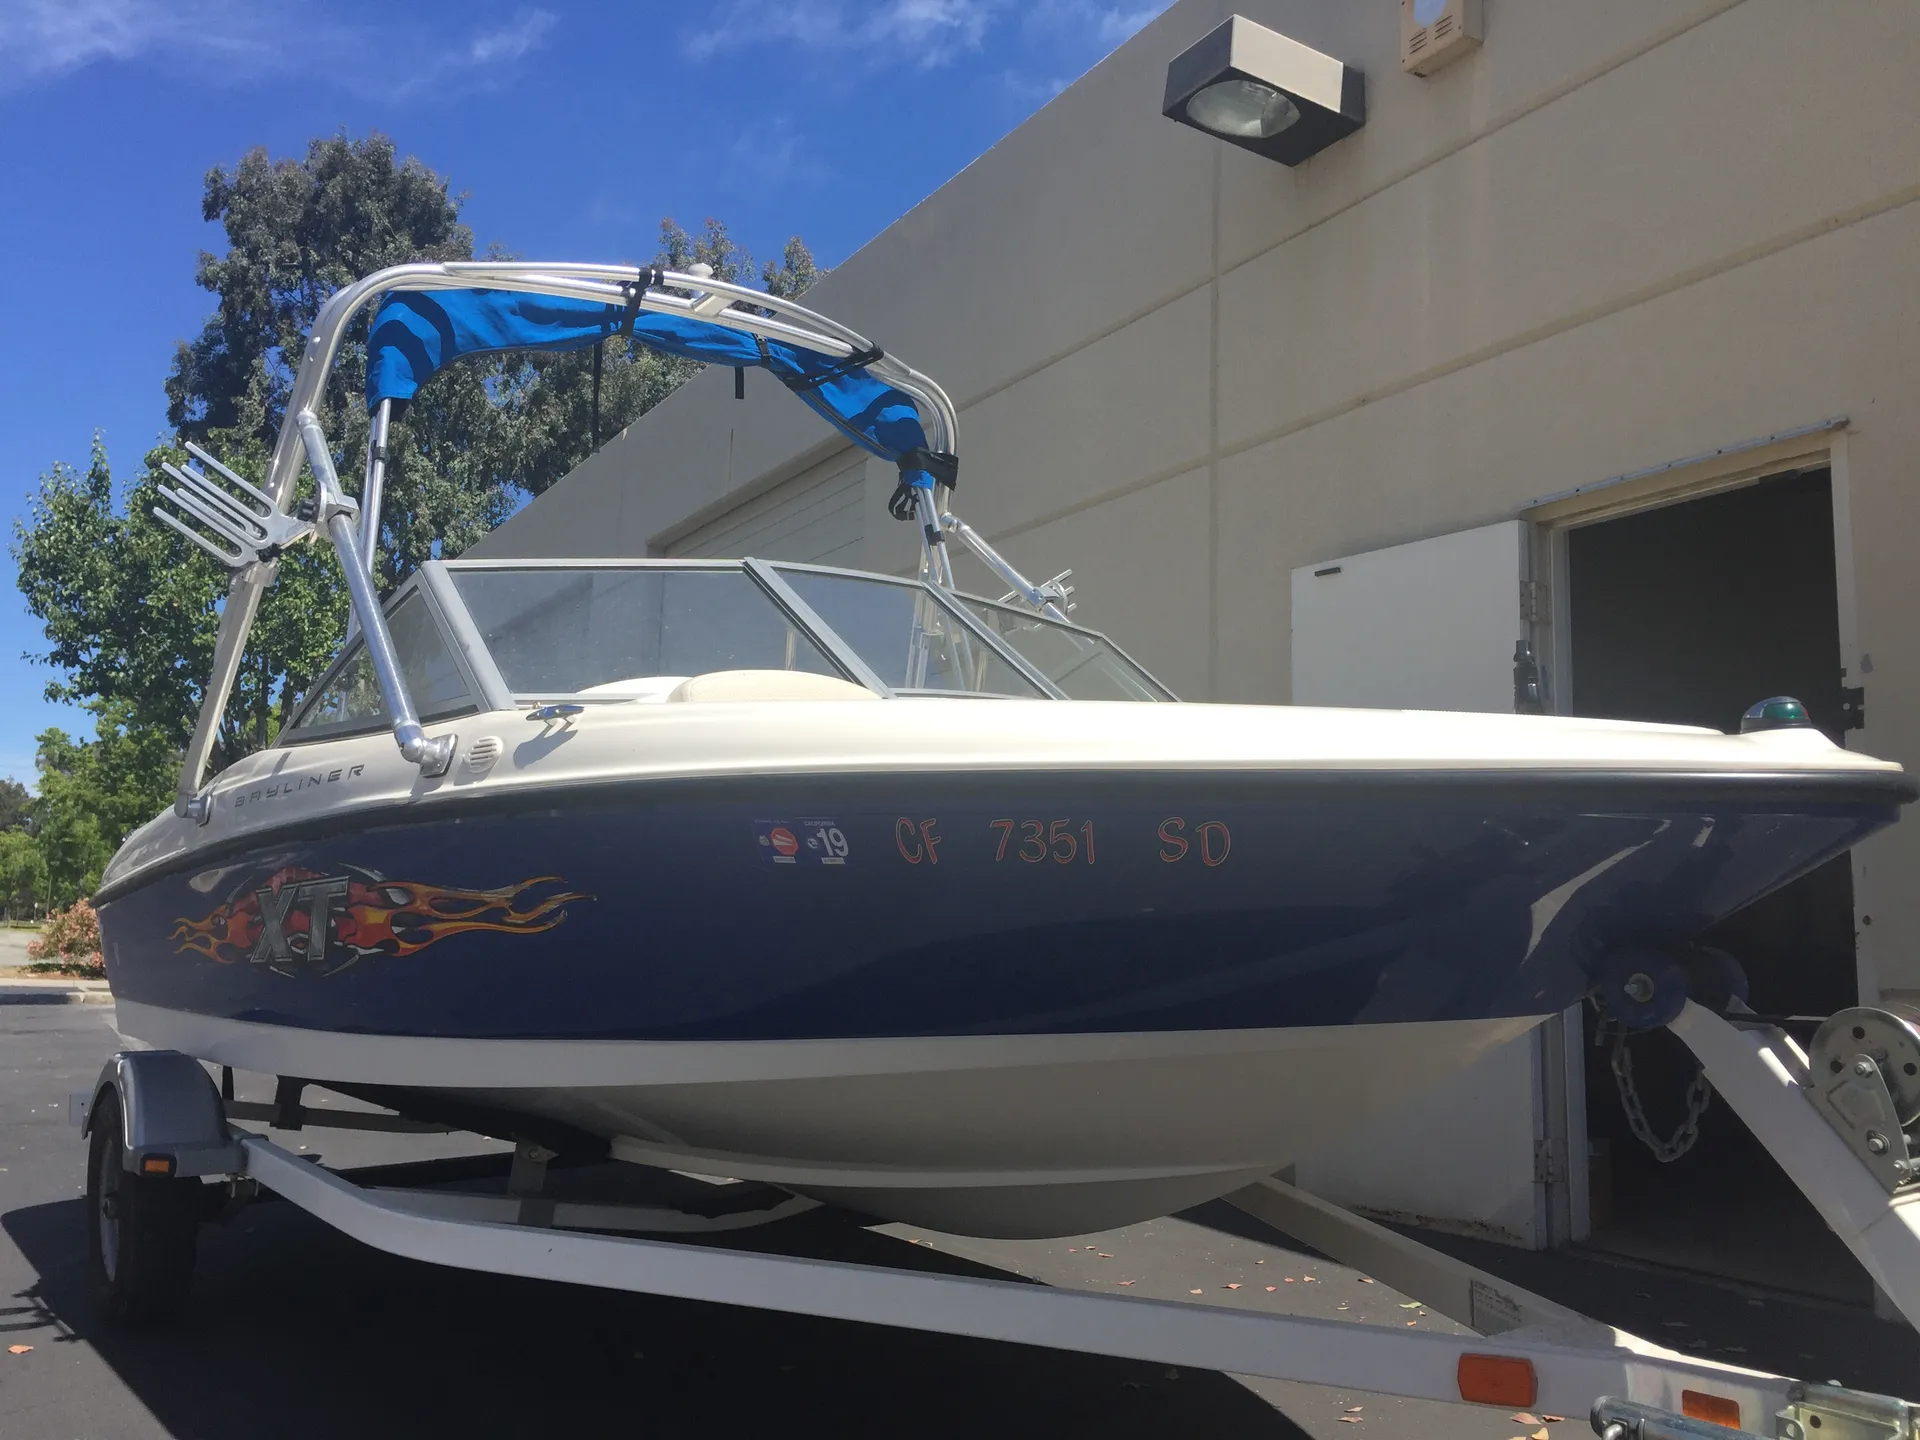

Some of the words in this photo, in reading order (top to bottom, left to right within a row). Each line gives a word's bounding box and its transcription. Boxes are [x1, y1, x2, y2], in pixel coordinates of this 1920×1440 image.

[234, 763, 365, 808] BAYLINER
[816, 827, 849, 857] 19
[895, 817, 942, 865] CF
[989, 818, 1095, 865] 7351
[250, 876, 350, 964] XT
